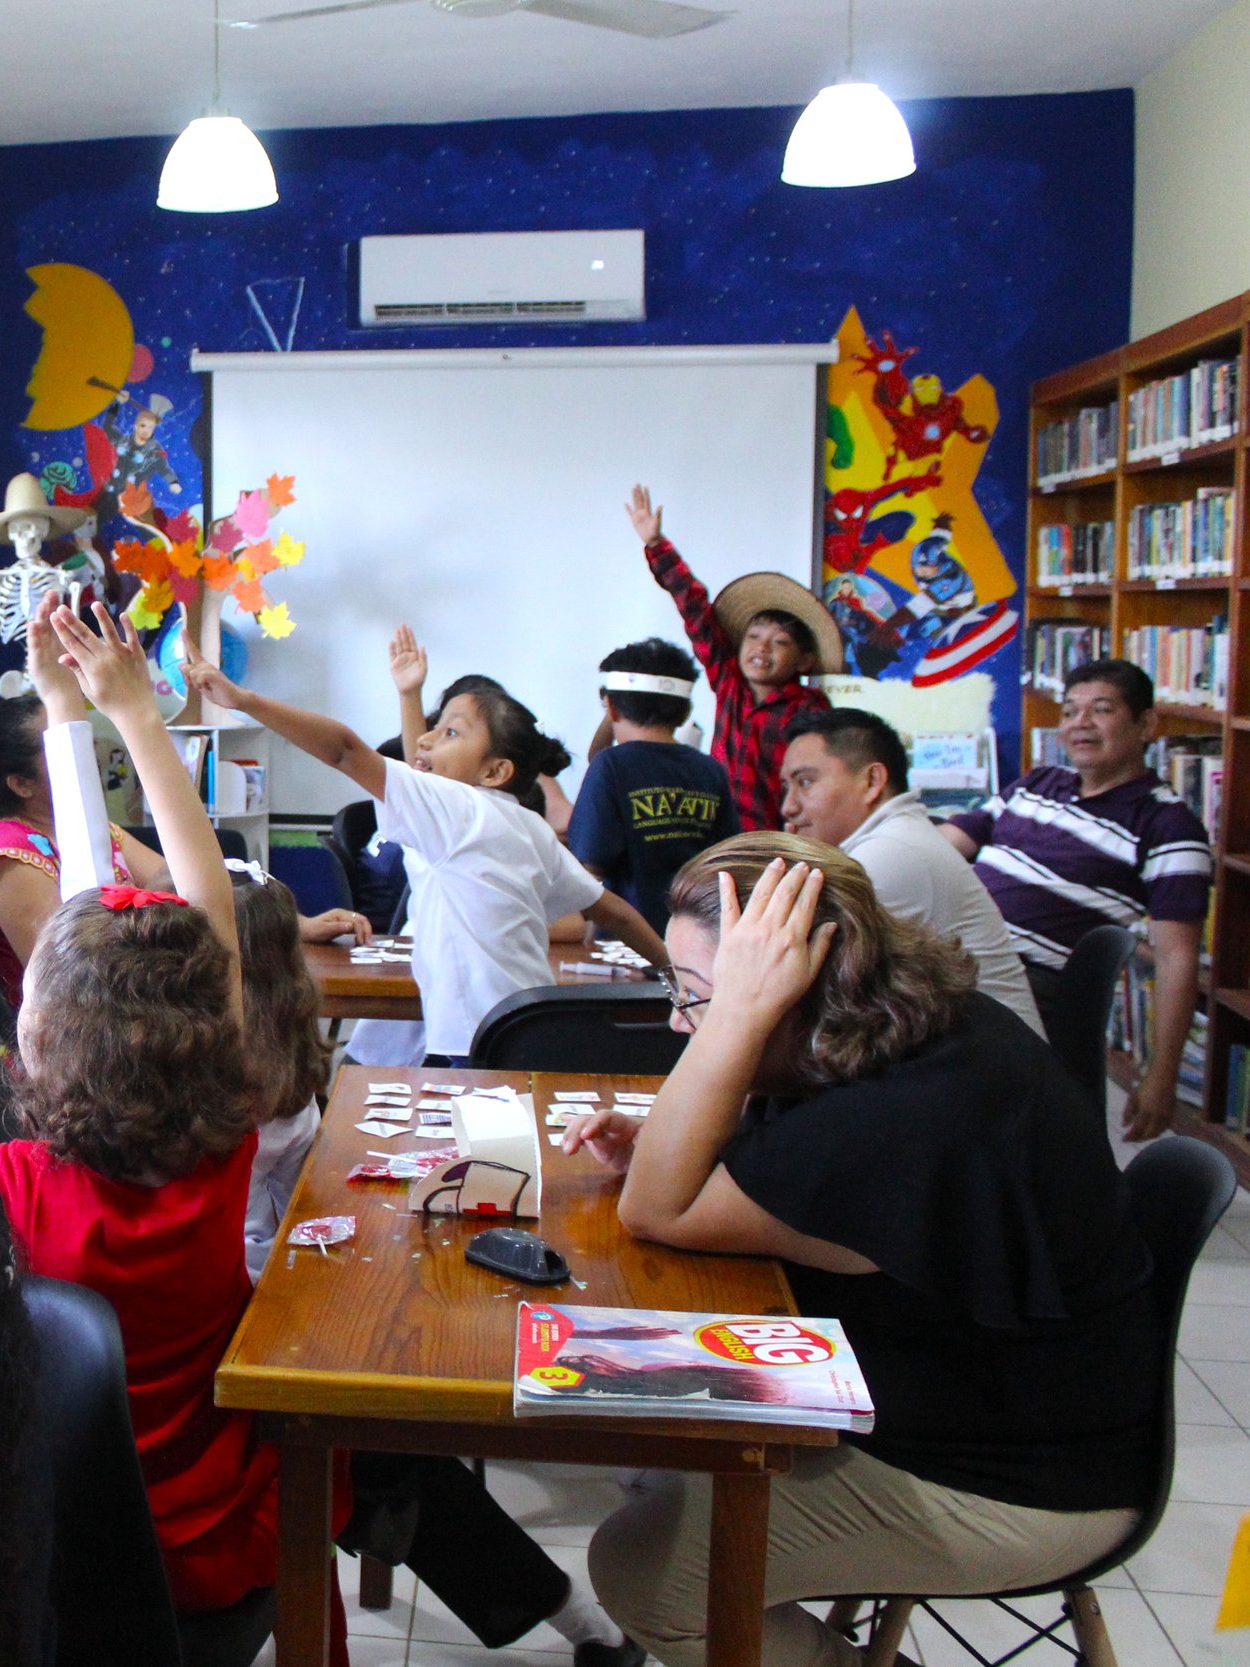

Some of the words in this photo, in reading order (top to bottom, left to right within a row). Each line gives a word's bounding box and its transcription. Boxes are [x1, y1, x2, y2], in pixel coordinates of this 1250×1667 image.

[710, 1329, 757, 1361] ENGLISH
[725, 1322, 830, 1364] BIG
[539, 1371, 569, 1380] 3
